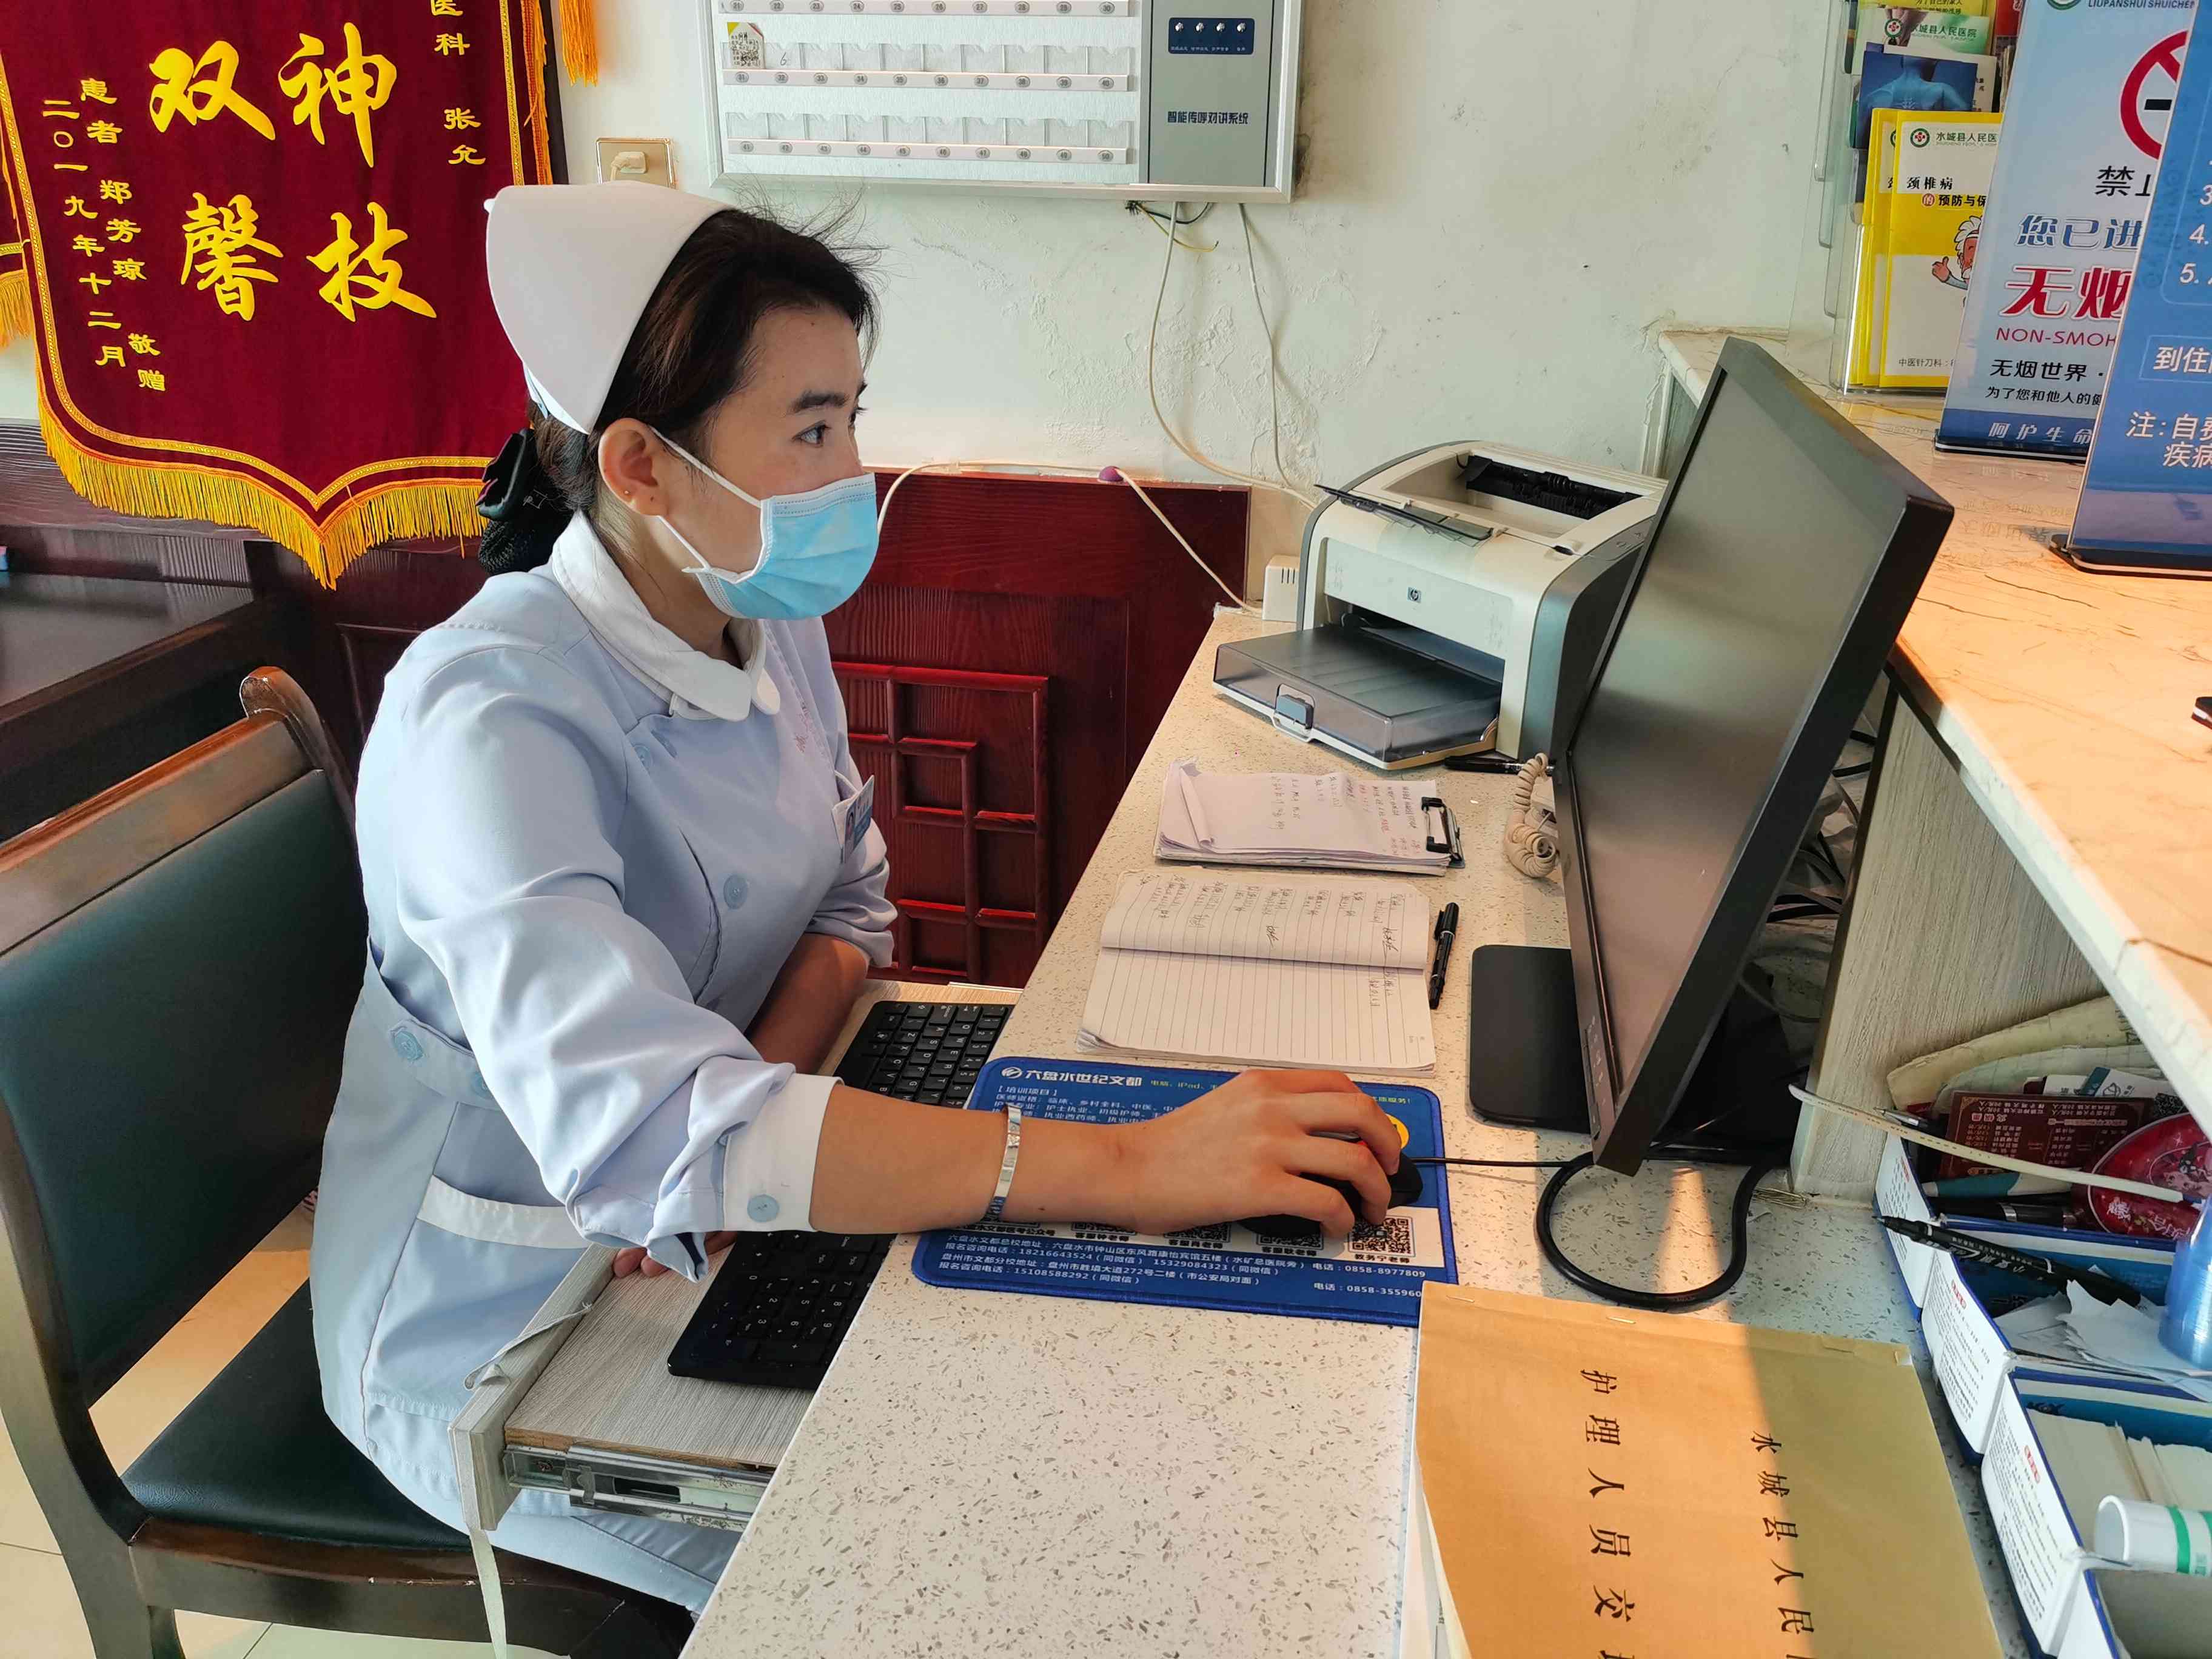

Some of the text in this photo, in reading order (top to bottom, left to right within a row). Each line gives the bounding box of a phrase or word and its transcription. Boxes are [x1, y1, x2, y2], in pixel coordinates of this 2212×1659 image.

[1167, 111, 1248, 124] 智能传呼对讲系统
[444, 108, 486, 165] 张允
[1936, 132, 1999, 142] 水城县人民医
[1907, 176, 1953, 190] 颈椎病
[80, 78, 123, 144] 患者
[128, 334, 166, 392] 敬赠
[2153, 346, 2212, 374] 到住
[1024, 1070, 1142, 1087] 六盘水世纪文都
[1579, 1368, 1637, 1659] 护理人员交
[1750, 1430, 1816, 1659] 水城县人民
